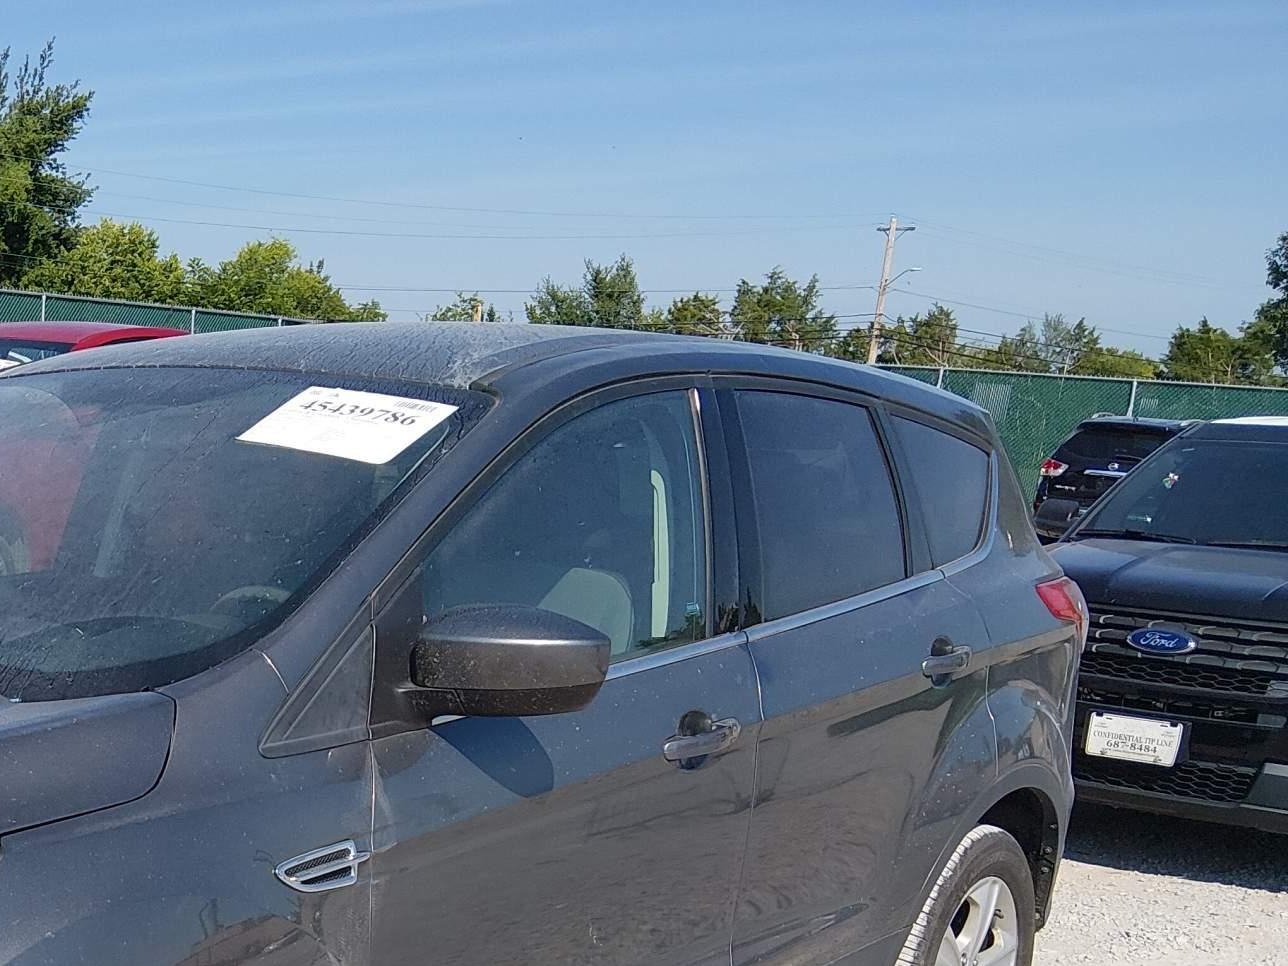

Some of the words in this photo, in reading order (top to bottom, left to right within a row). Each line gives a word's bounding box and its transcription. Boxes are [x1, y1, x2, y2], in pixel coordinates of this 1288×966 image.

[300, 400, 416, 426] 45439786
[1140, 631, 1179, 648] Ford
[1093, 730, 1143, 743] CONFIDENTIAL
[1156, 738, 1174, 748] LINE
